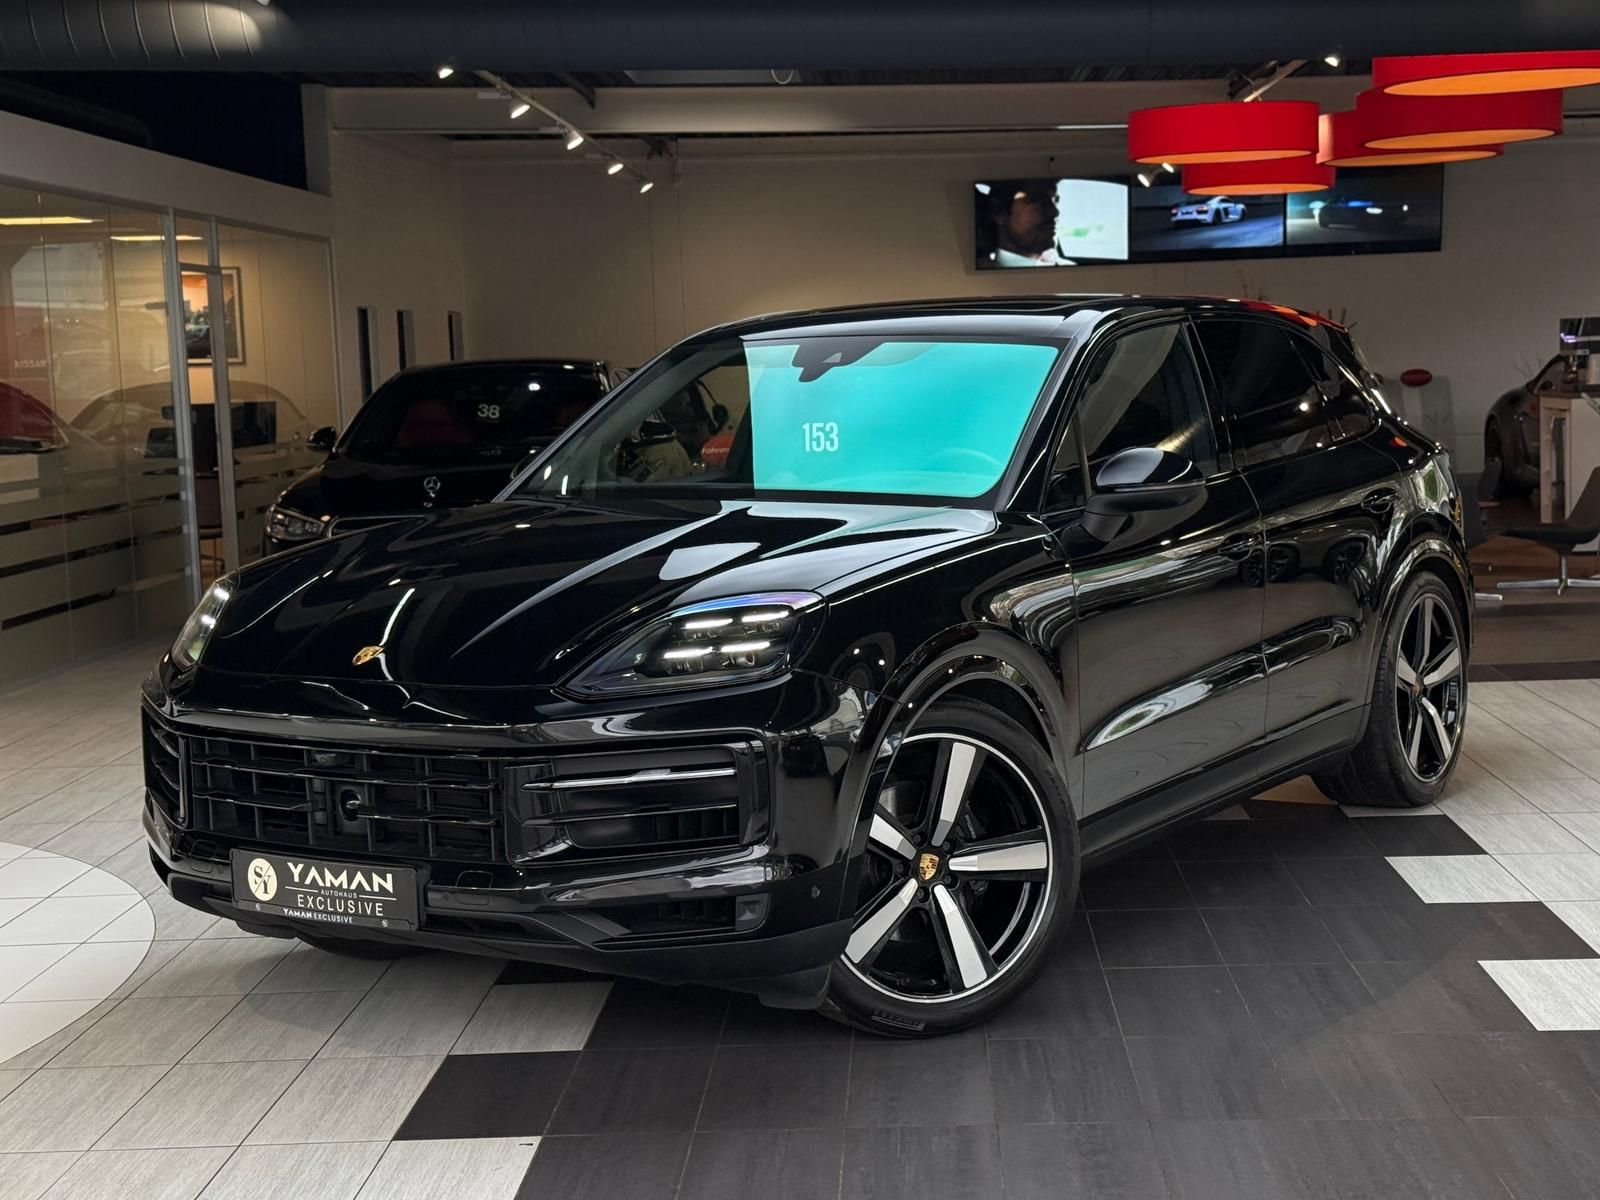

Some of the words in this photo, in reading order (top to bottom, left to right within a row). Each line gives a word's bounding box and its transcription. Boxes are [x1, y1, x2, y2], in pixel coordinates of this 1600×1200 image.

[477, 403, 501, 419] 38
[802, 421, 839, 452] 153
[287, 862, 394, 894] YAMAN
[320, 889, 358, 899] AUTOHAUS
[297, 894, 384, 917] EXCLUSIVE
[283, 908, 312, 919] YAMAN
[313, 912, 353, 924] EXCLUSIVE
